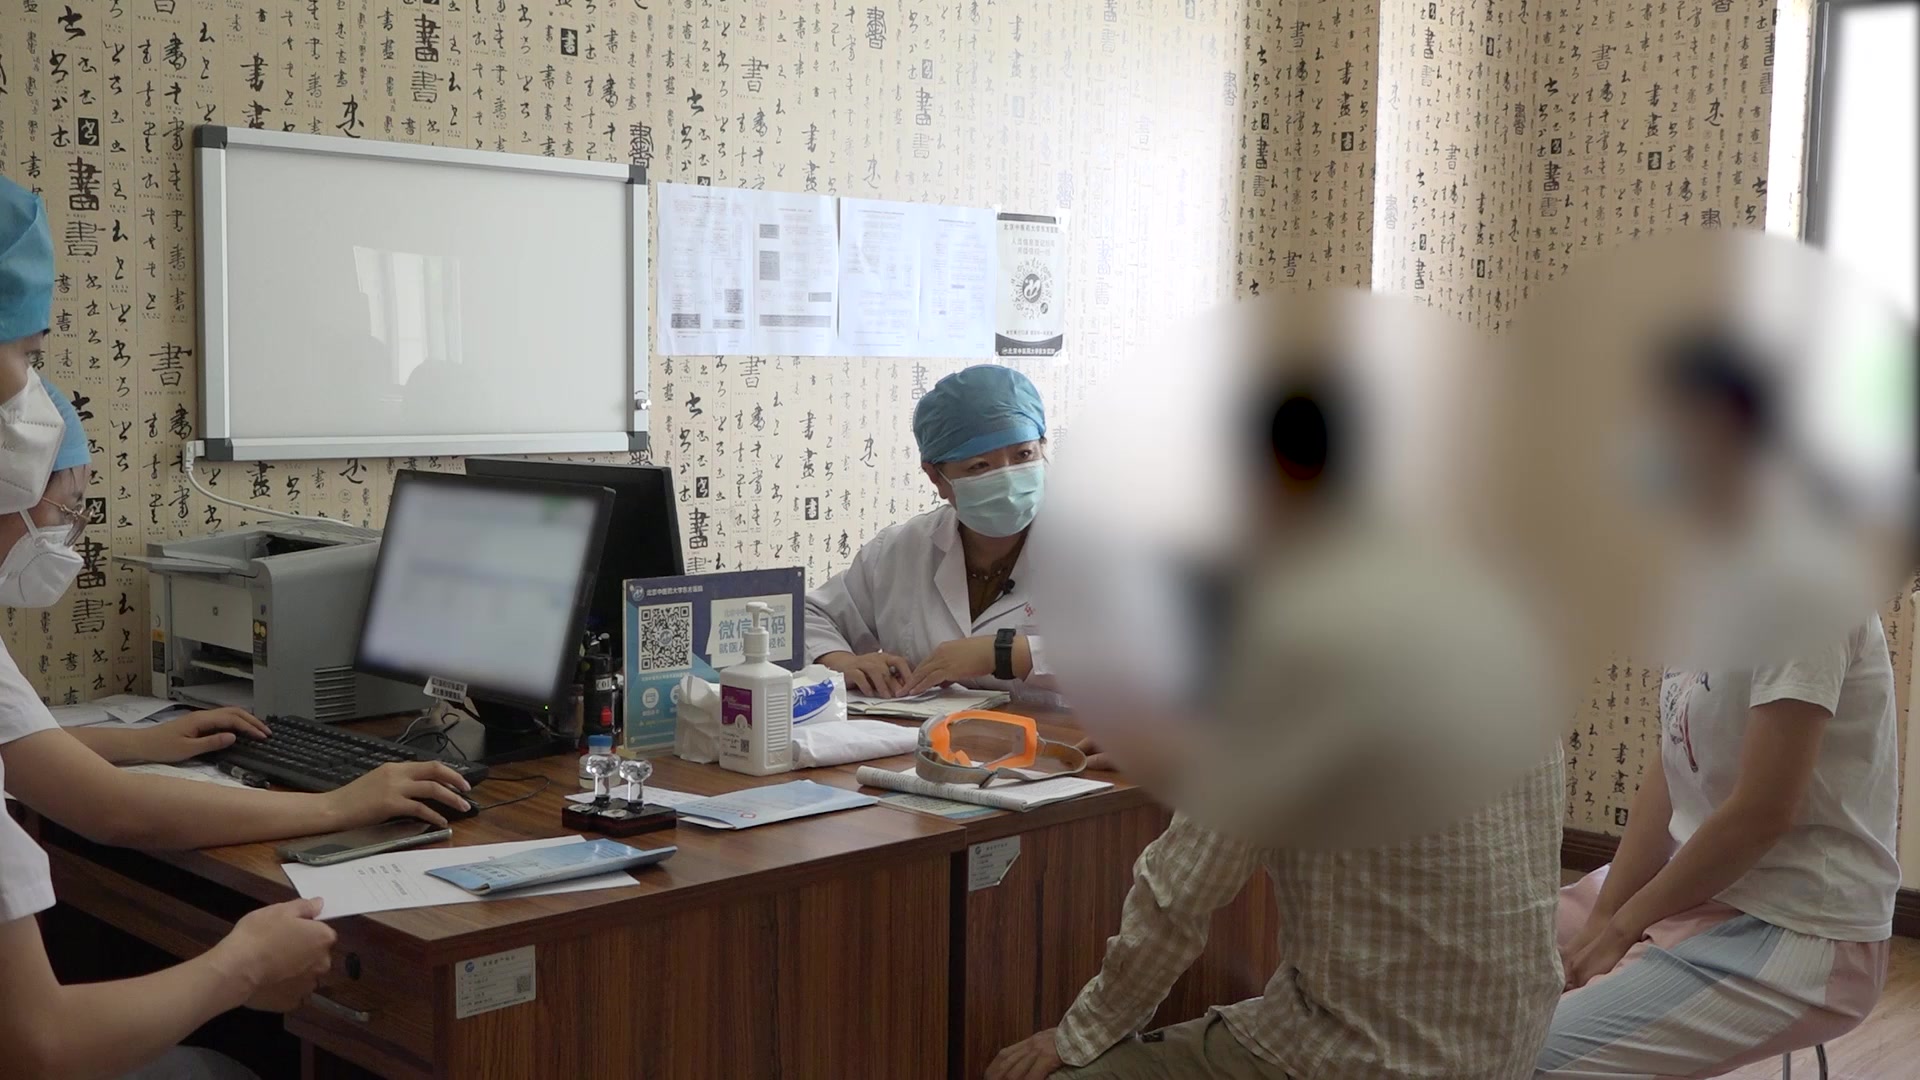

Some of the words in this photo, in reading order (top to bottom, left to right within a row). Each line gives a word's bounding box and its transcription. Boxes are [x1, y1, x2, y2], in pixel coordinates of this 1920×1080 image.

[1592, 43, 1616, 71] 書
[741, 56, 769, 93] 書
[149, 342, 192, 387] 書
[719, 637, 786, 654] 就医轻松
